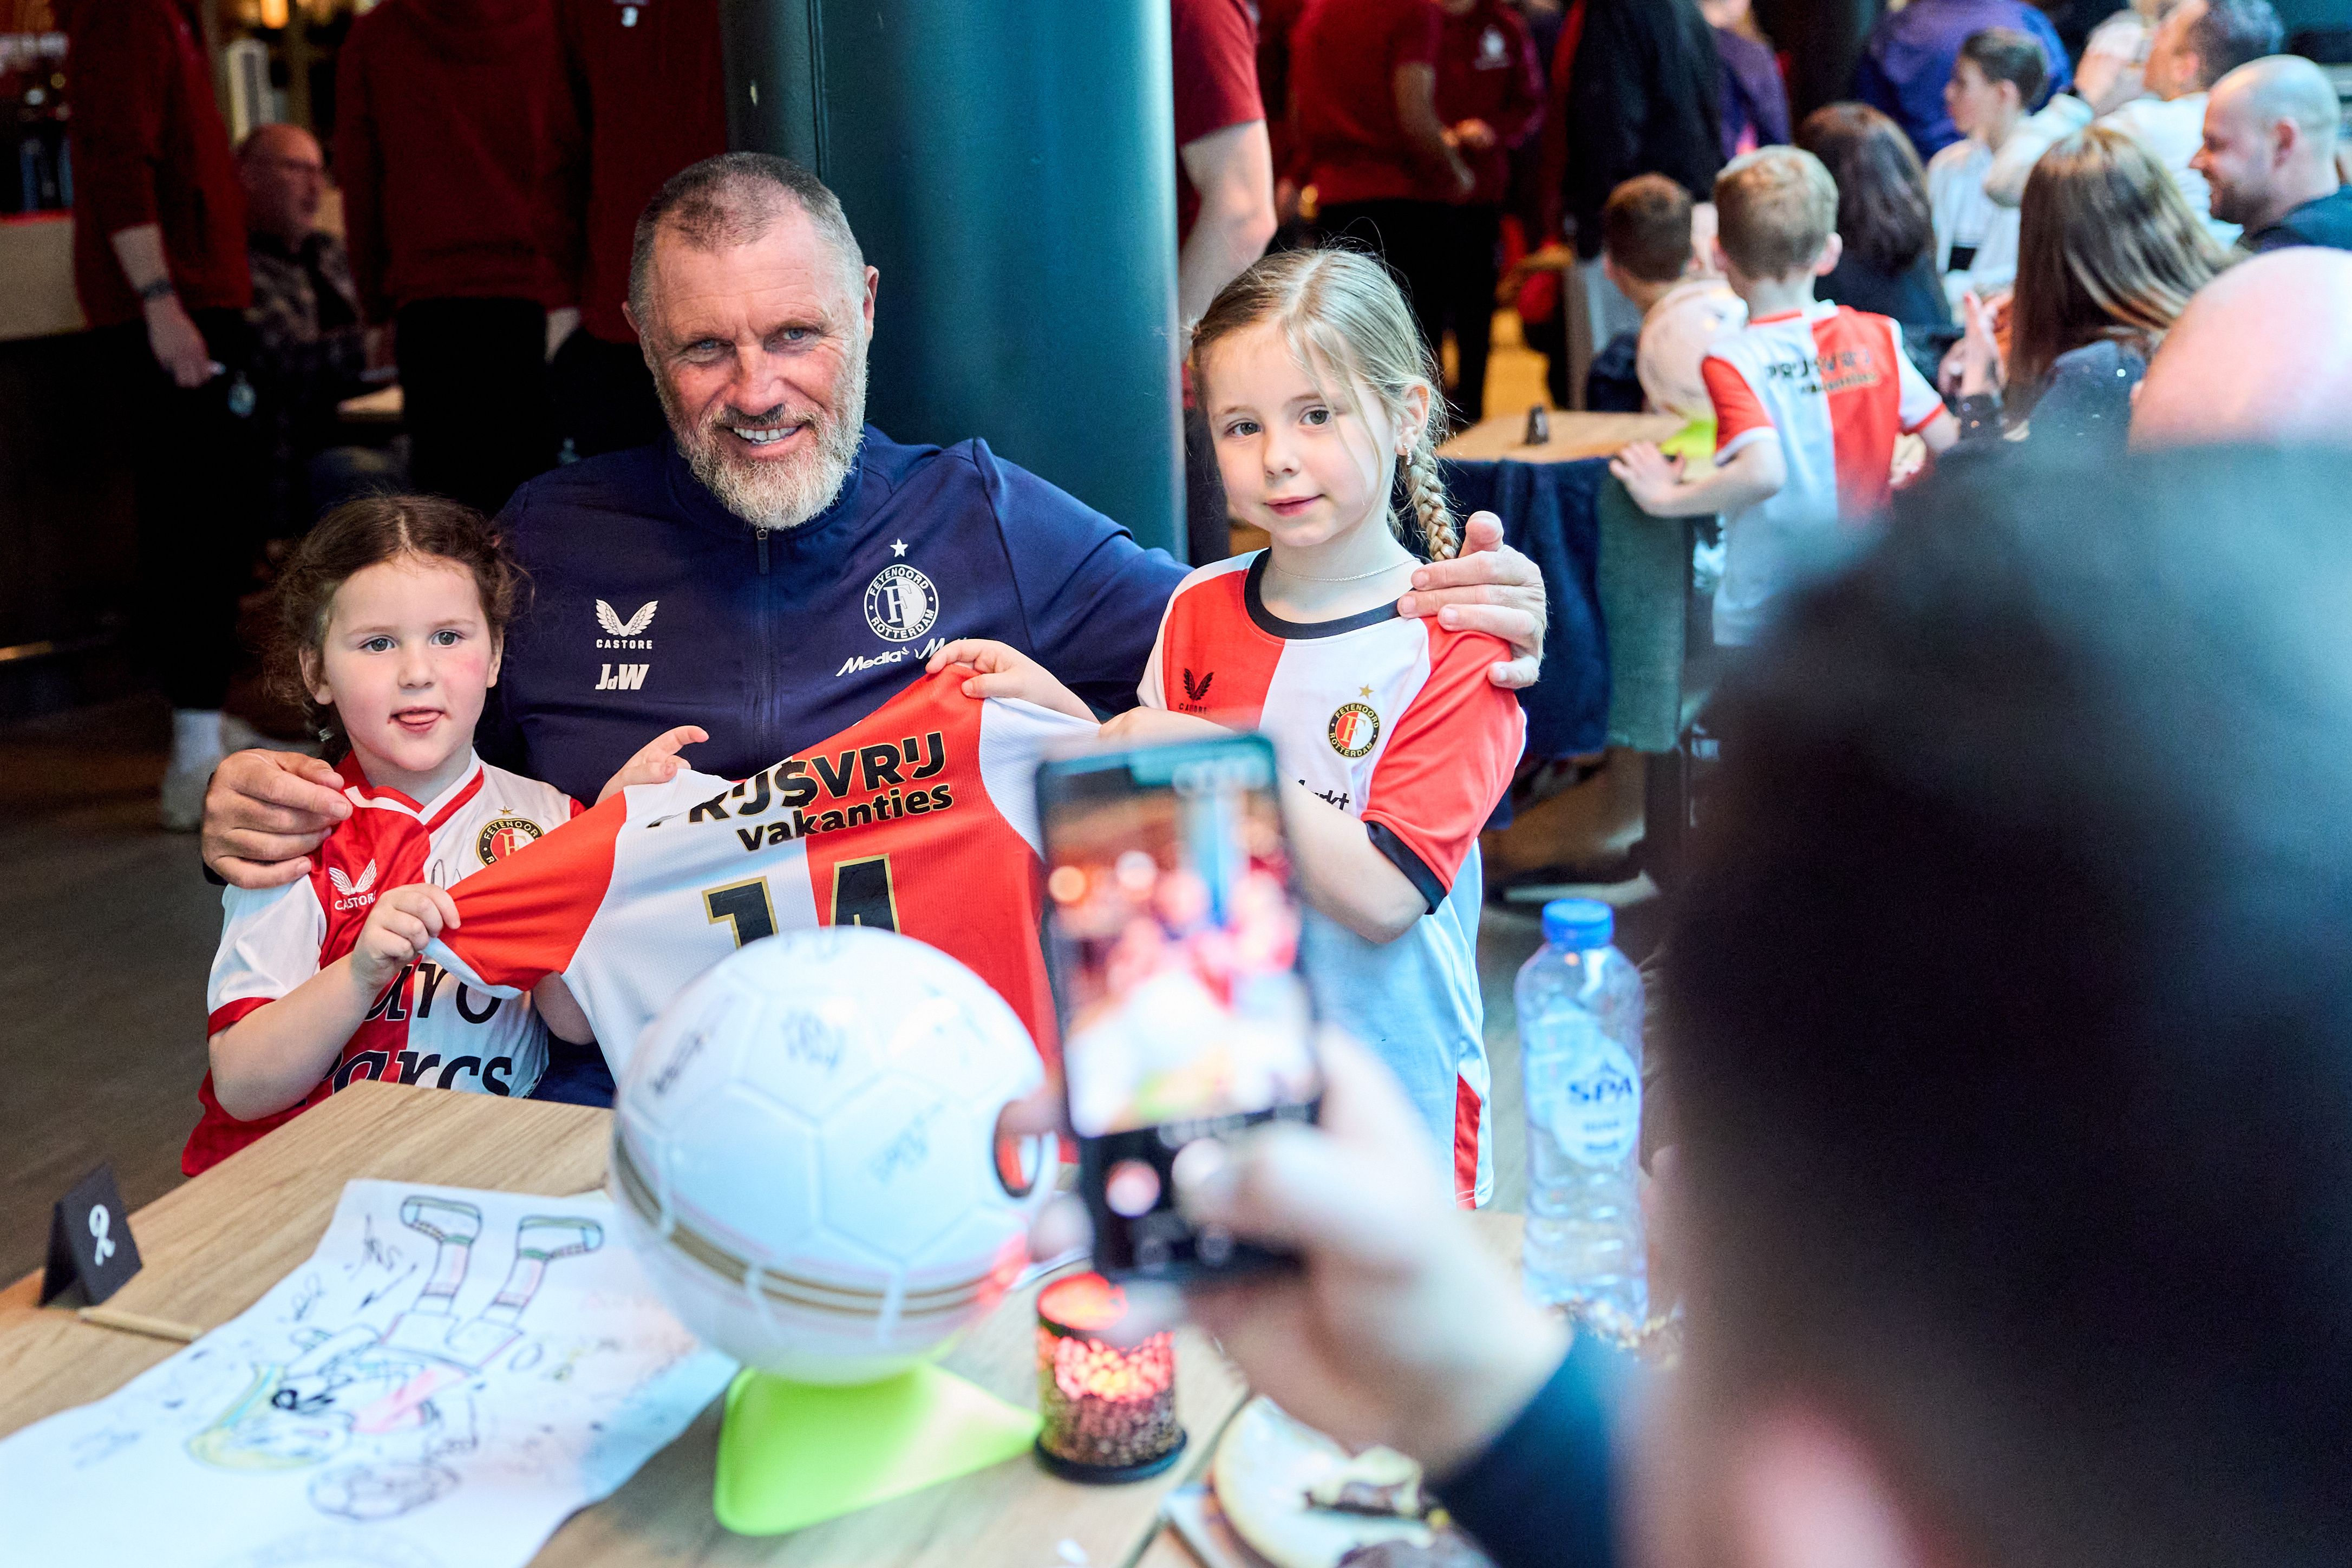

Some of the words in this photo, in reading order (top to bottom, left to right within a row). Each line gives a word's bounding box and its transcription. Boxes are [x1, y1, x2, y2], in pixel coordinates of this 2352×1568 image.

[869, 567, 929, 597] FEYENOORD
[883, 584, 912, 624] F
[871, 609, 935, 639] ROTTERDAM
[596, 639, 653, 650] CASTORE
[594, 664, 650, 690] JdW
[1335, 704, 1379, 728] FEYENOORD
[1329, 732, 1373, 757] ROTTERDAM
[484, 821, 539, 840] FEYENOOR
[736, 783, 953, 852] vakanties
